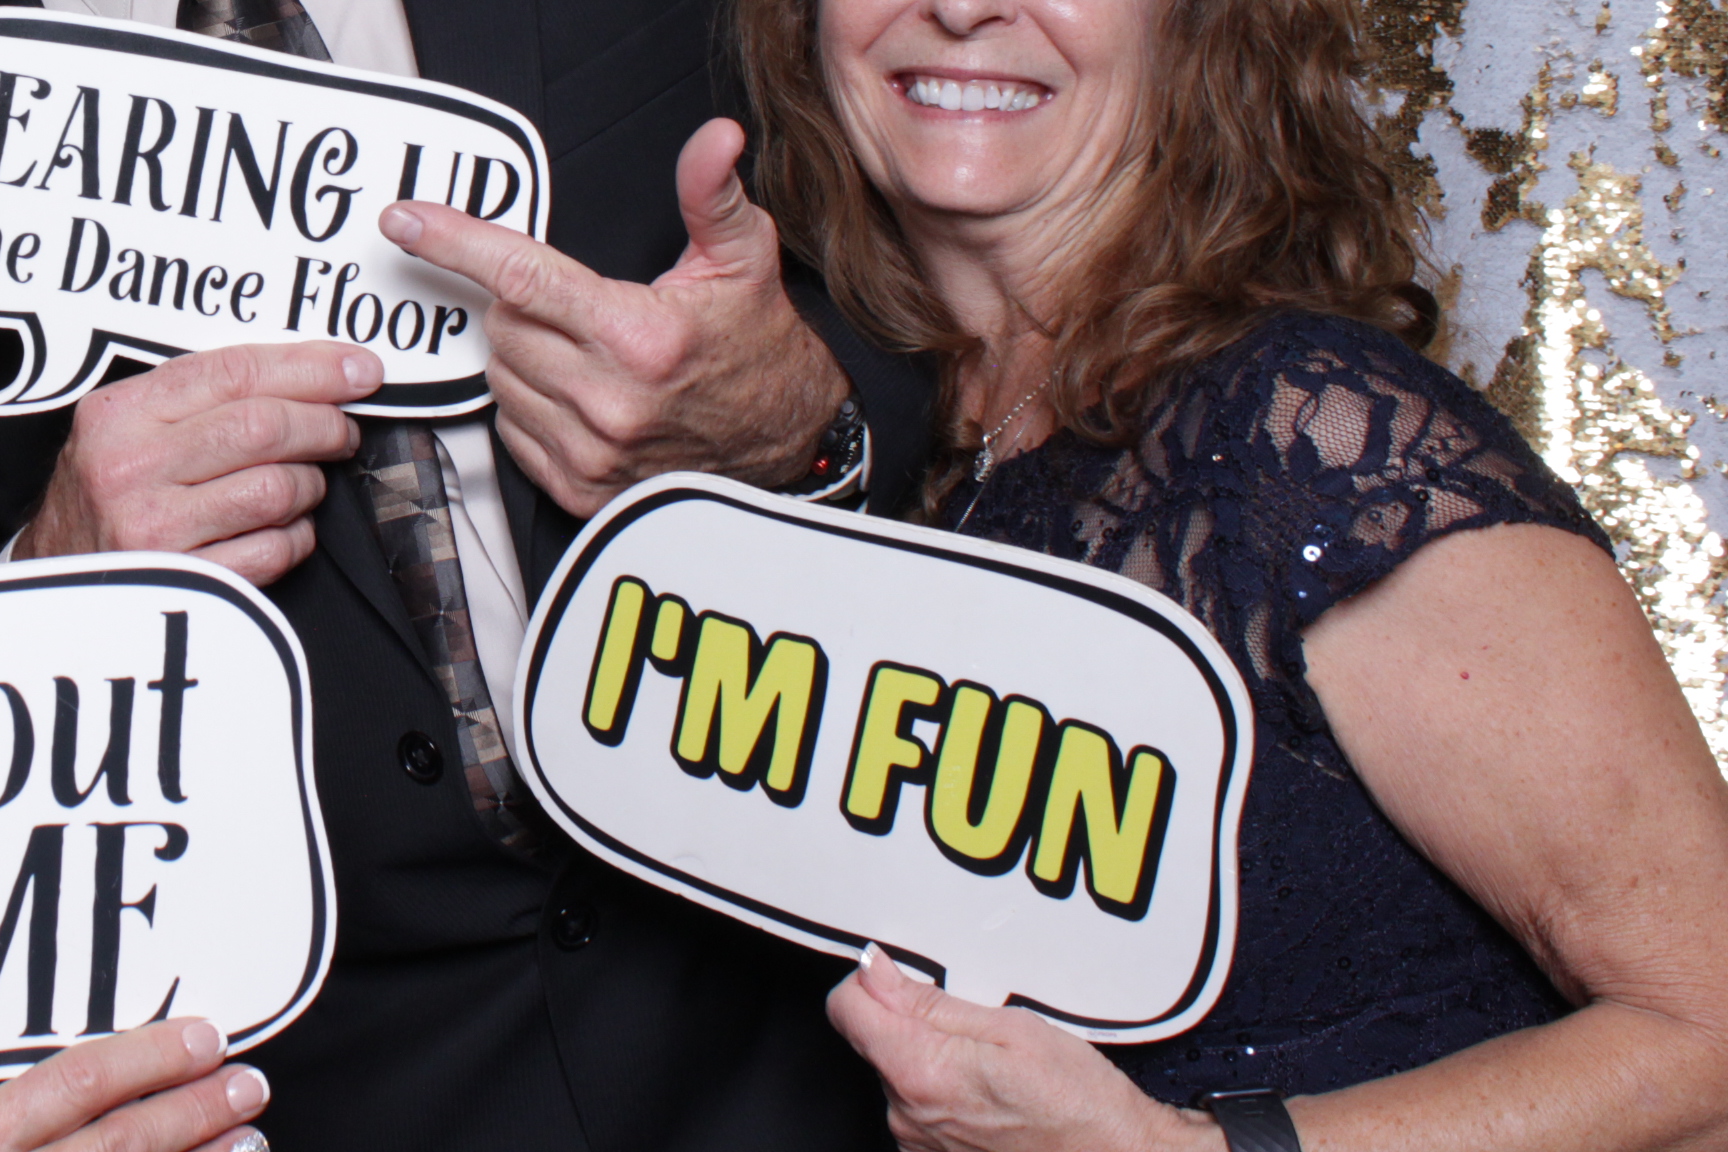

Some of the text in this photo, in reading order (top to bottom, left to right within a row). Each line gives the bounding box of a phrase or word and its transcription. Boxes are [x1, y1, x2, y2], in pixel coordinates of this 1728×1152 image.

[58, 216, 265, 323] Dance
[282, 255, 469, 356] Floor
[582, 574, 1178, 923] I'M FUN
